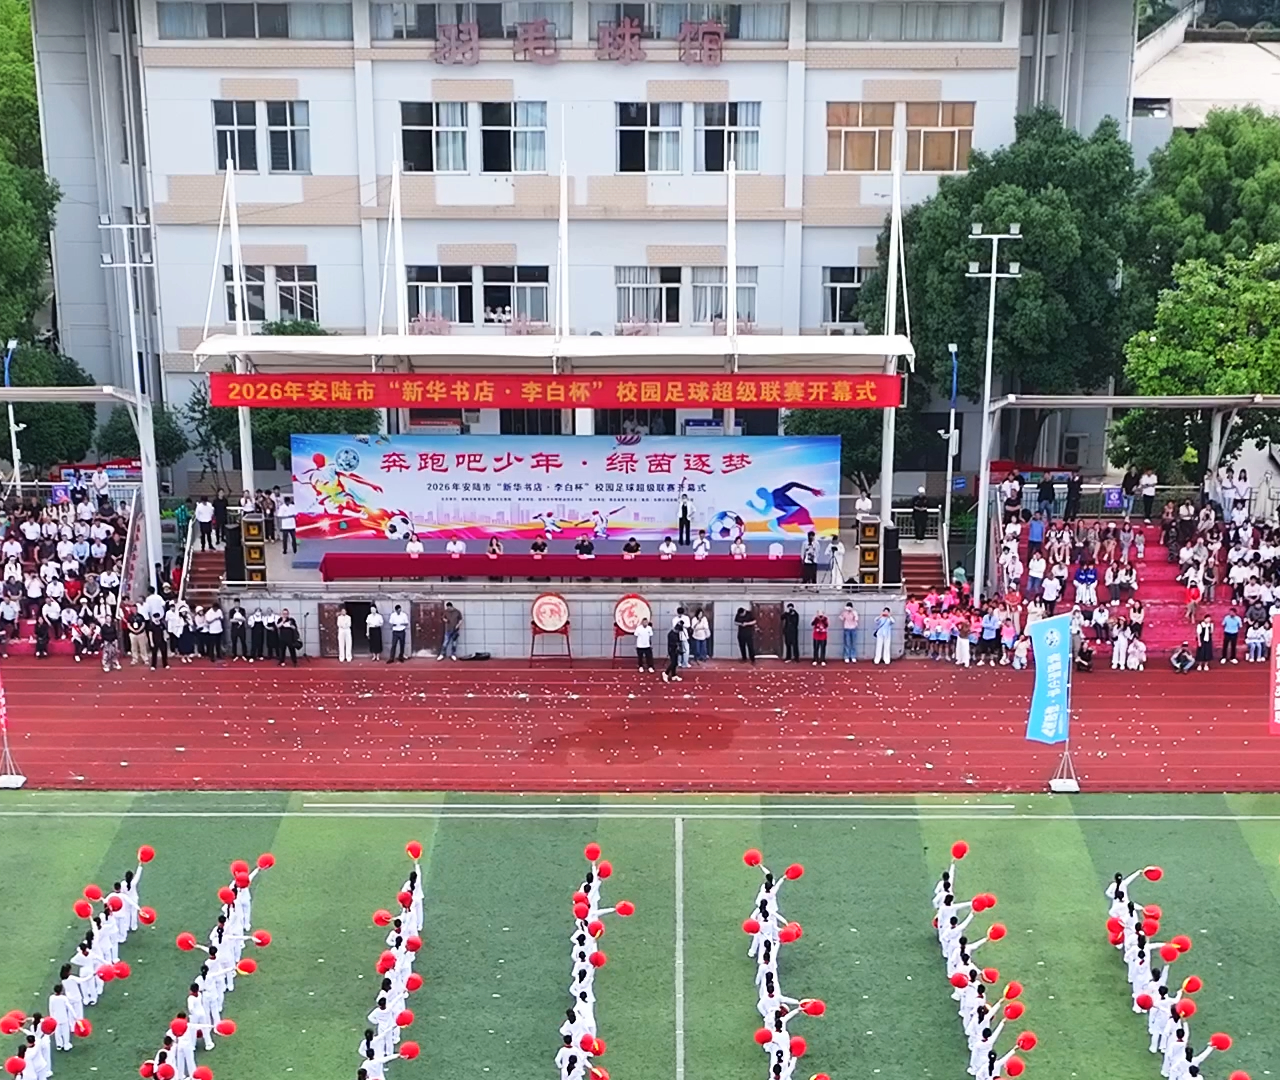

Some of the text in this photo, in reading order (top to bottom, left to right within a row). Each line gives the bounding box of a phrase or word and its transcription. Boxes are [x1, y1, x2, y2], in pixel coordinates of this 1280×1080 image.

[429, 16, 726, 66] 羽毛球馆
[380, 452, 752, 474] 奔跑吧少年·绿茵逐梦
